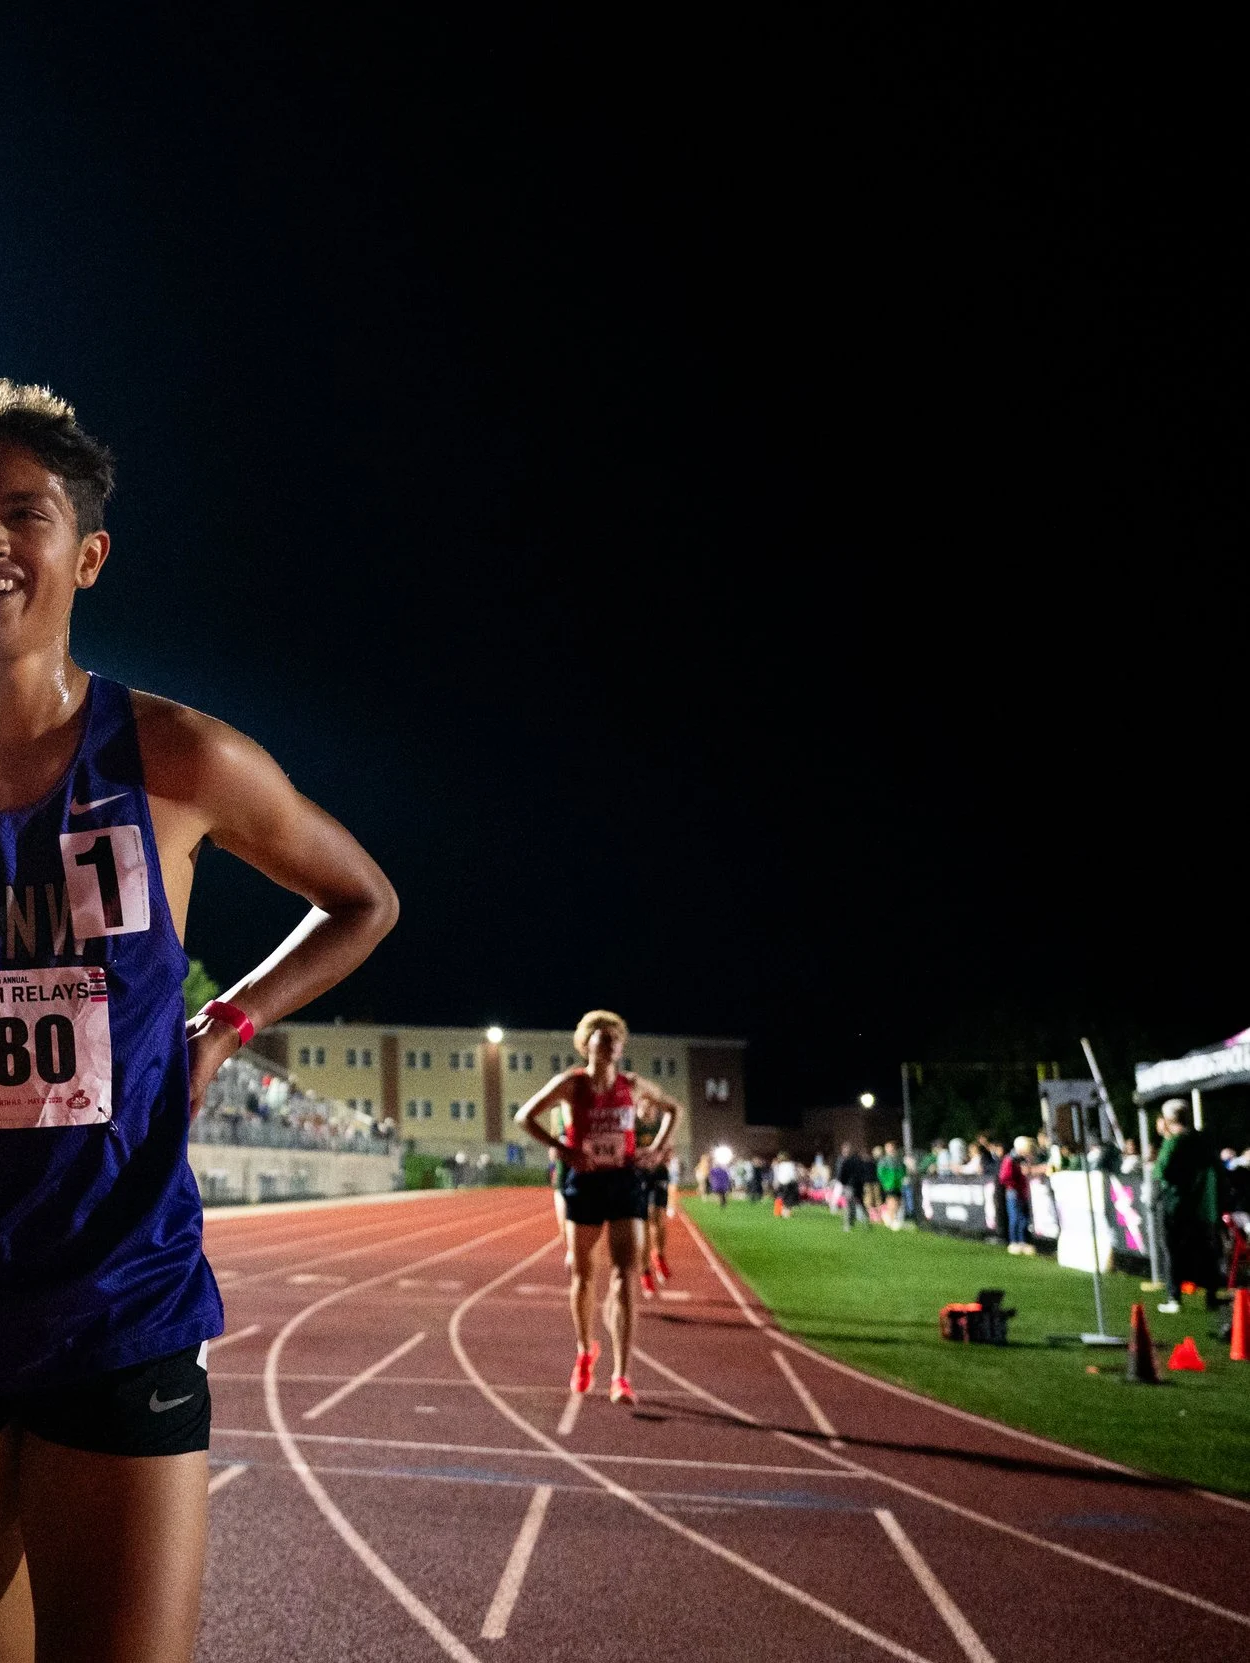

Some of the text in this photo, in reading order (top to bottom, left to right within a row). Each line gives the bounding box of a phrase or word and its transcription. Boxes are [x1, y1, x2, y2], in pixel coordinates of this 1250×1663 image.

[75, 835, 124, 928] 1
[3, 976, 29, 984] ANNUAL
[12, 982, 89, 1003] RELAYS
